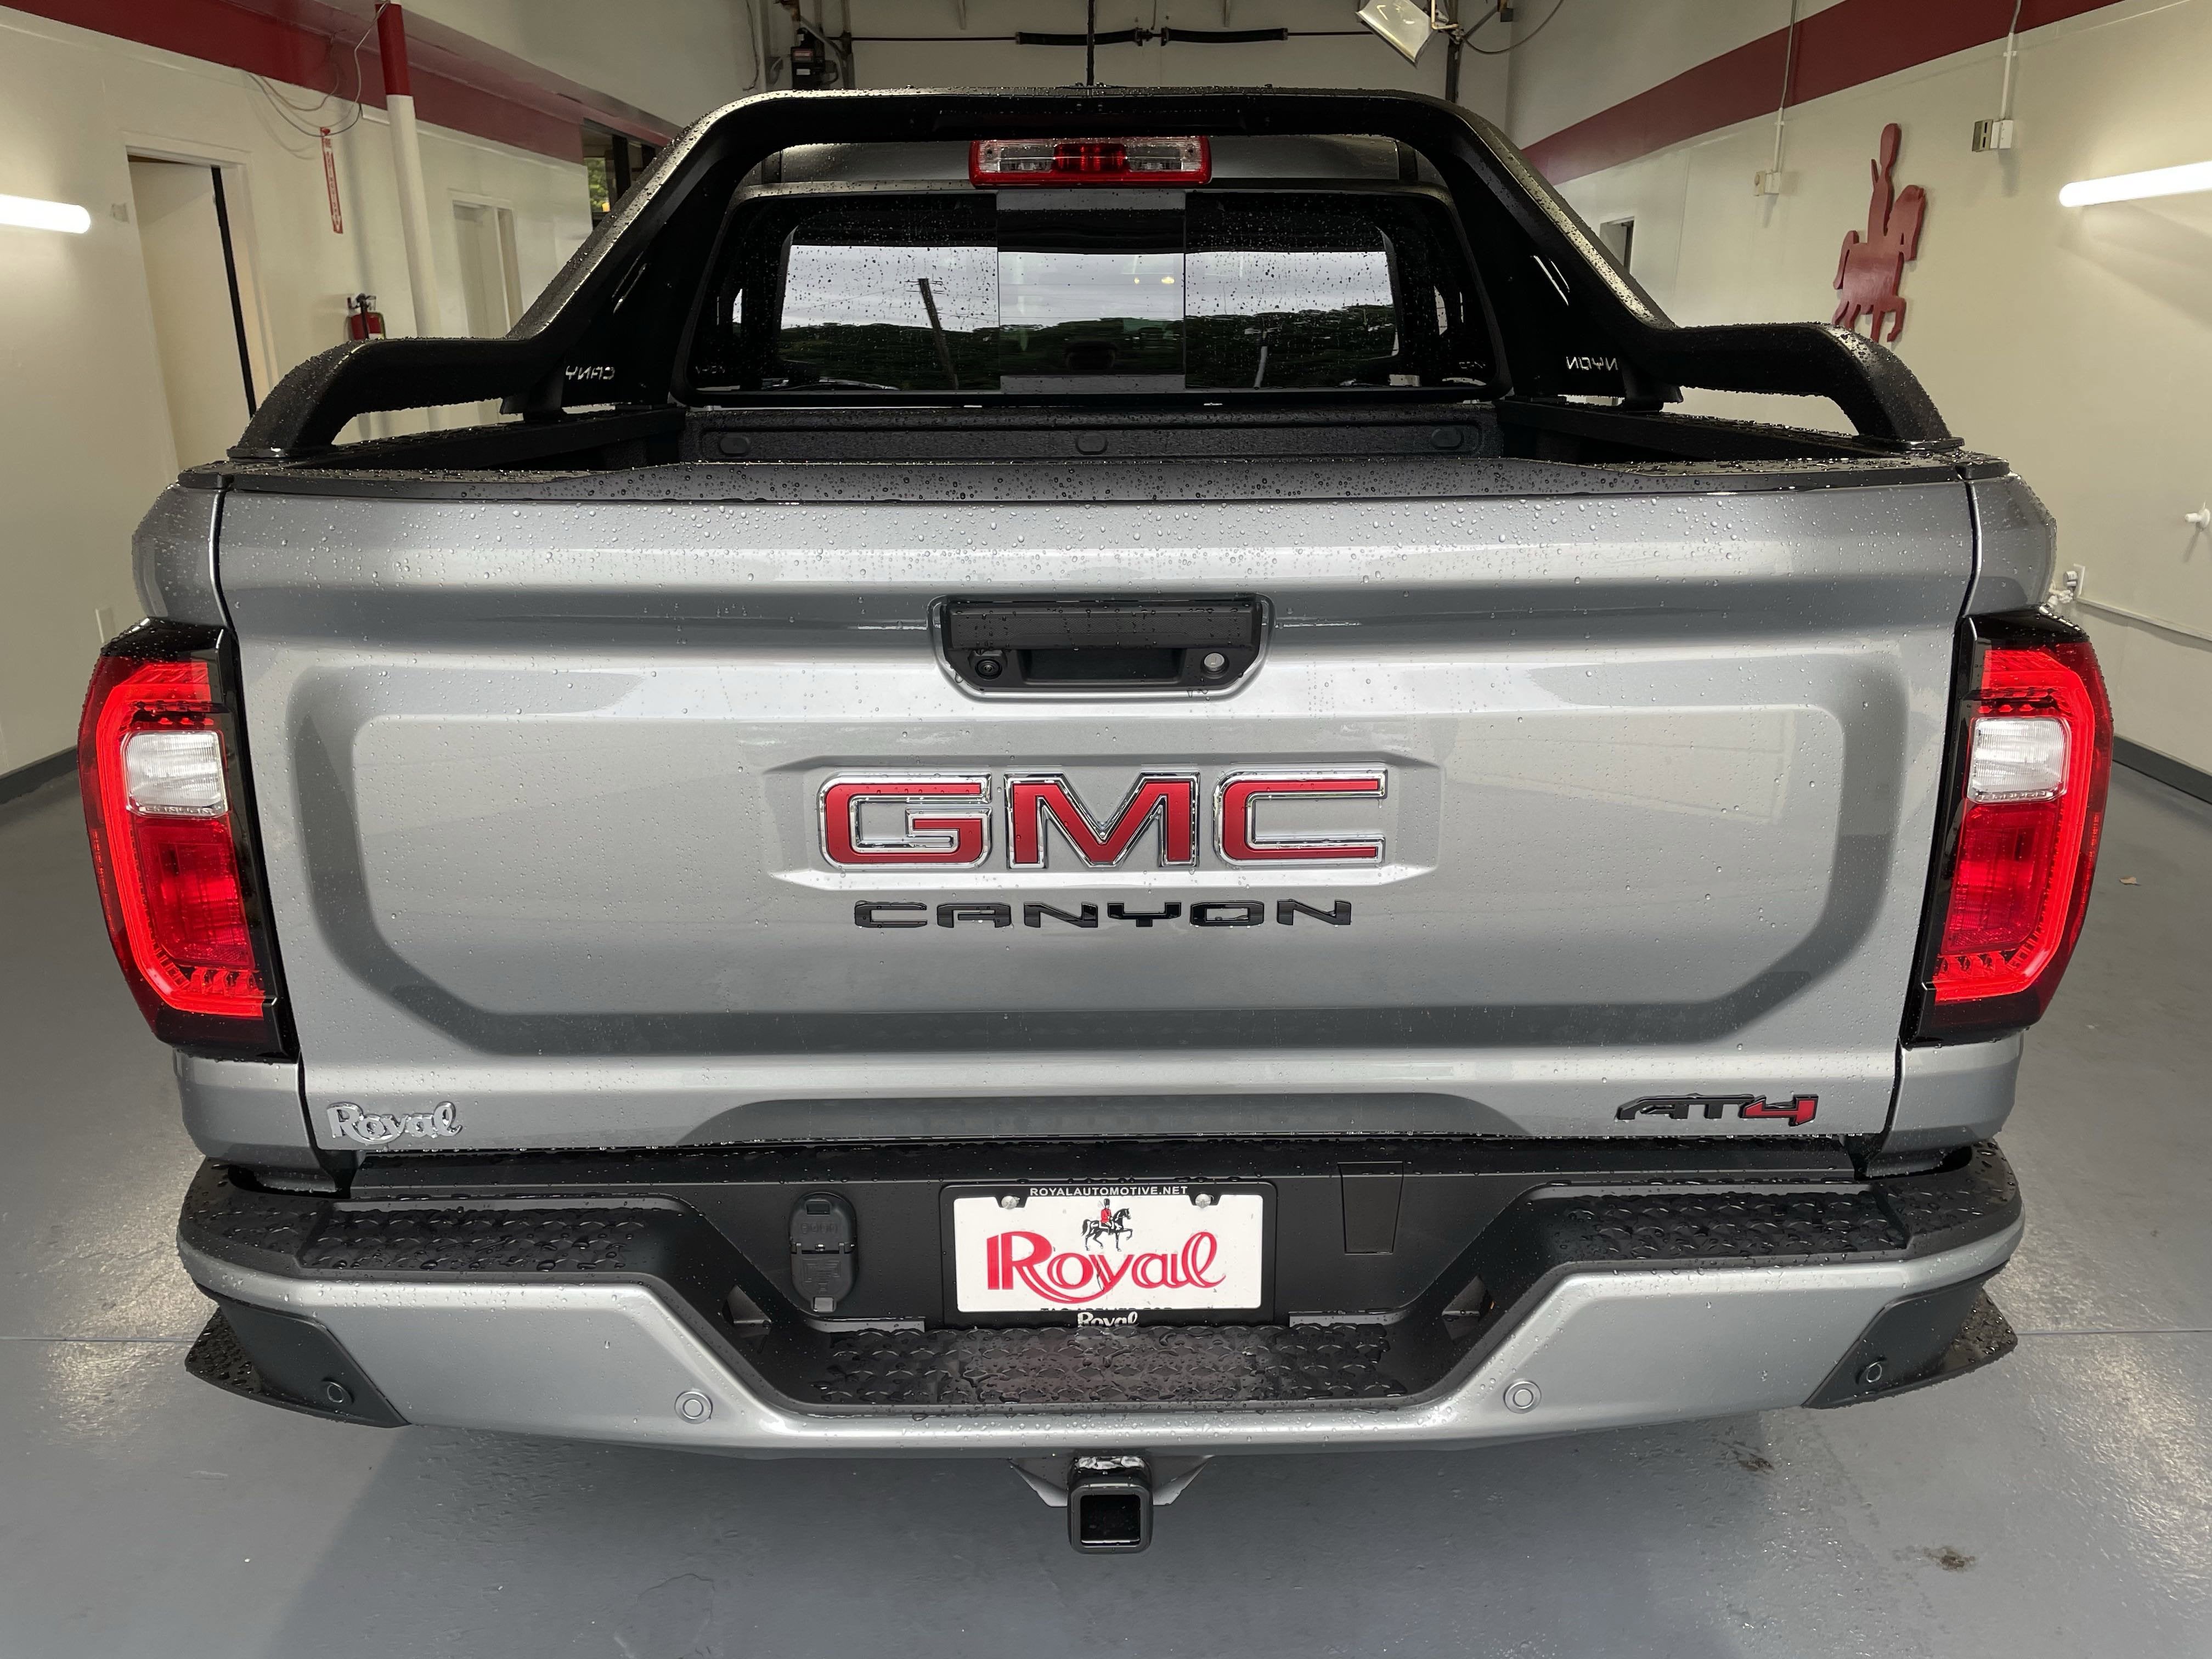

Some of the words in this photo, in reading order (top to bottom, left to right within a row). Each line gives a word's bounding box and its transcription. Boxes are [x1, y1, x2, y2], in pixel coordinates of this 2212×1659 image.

[817, 770, 1389, 869] GMC
[854, 900, 1352, 928] CANYON
[326, 1101, 462, 1146] Royal
[1615, 1093, 1819, 1127] AT4
[1030, 1186, 1188, 1197] ROYALAUTOMOTIVE.NET
[986, 1231, 1226, 1304] Royal
